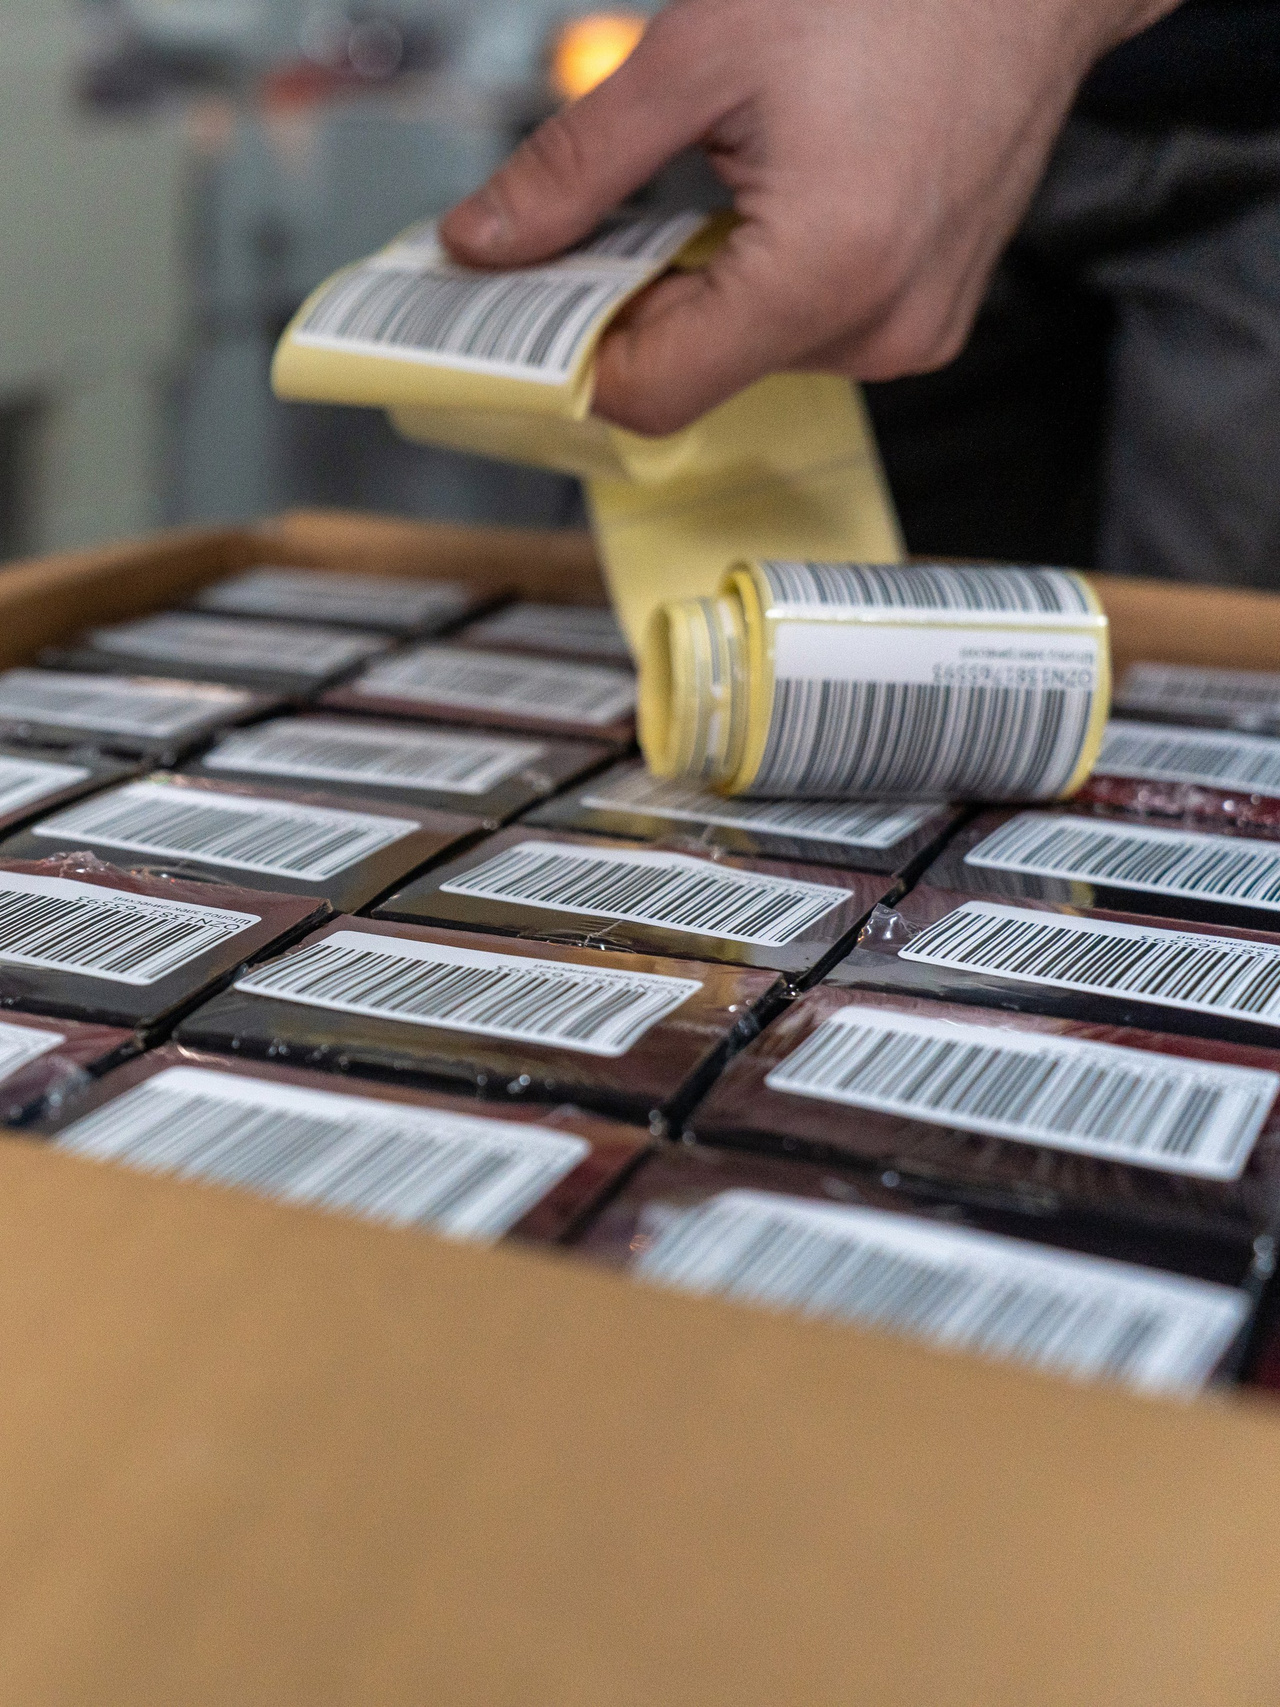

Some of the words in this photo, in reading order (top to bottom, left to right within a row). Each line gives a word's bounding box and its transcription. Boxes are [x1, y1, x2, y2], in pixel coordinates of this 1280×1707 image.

[76, 895, 241, 931] OZN1381765593
[113, 896, 202, 914] электрический
[203, 911, 252, 926] Штопор
